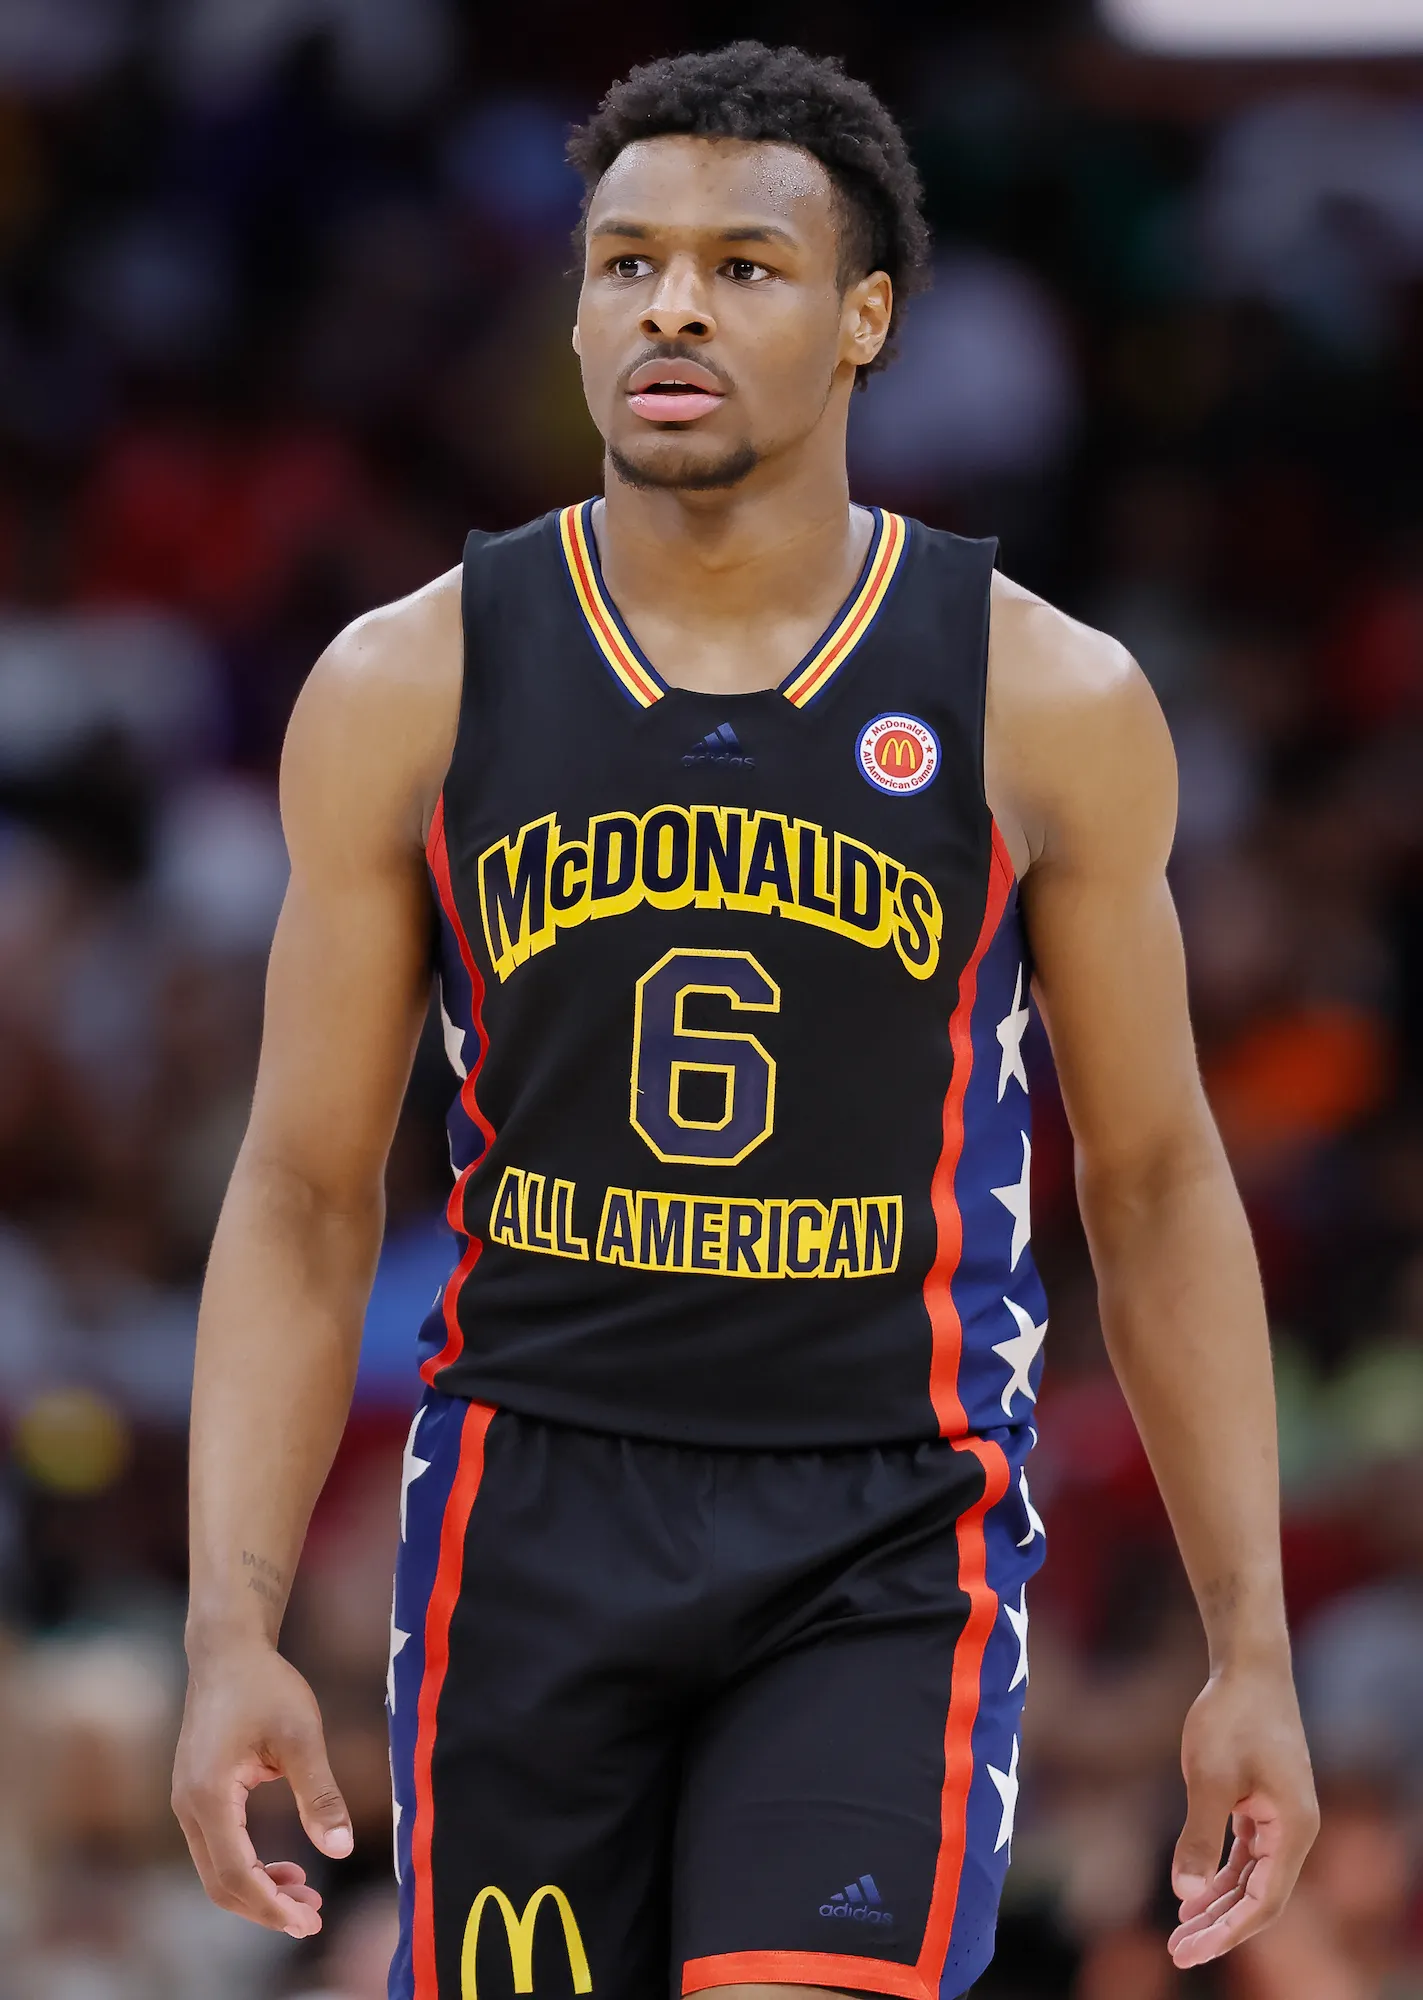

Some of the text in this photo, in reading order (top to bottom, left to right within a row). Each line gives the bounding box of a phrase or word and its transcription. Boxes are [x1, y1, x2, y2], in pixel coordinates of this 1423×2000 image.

[871, 720, 928, 742] McDonald's
[862, 750, 934, 790] All American Games
[478, 804, 943, 983] McDONALD'S
[630, 947, 781, 1166] 6
[489, 1166, 903, 1279] ALL AMERICAN
[819, 1902, 894, 1926] adidas
